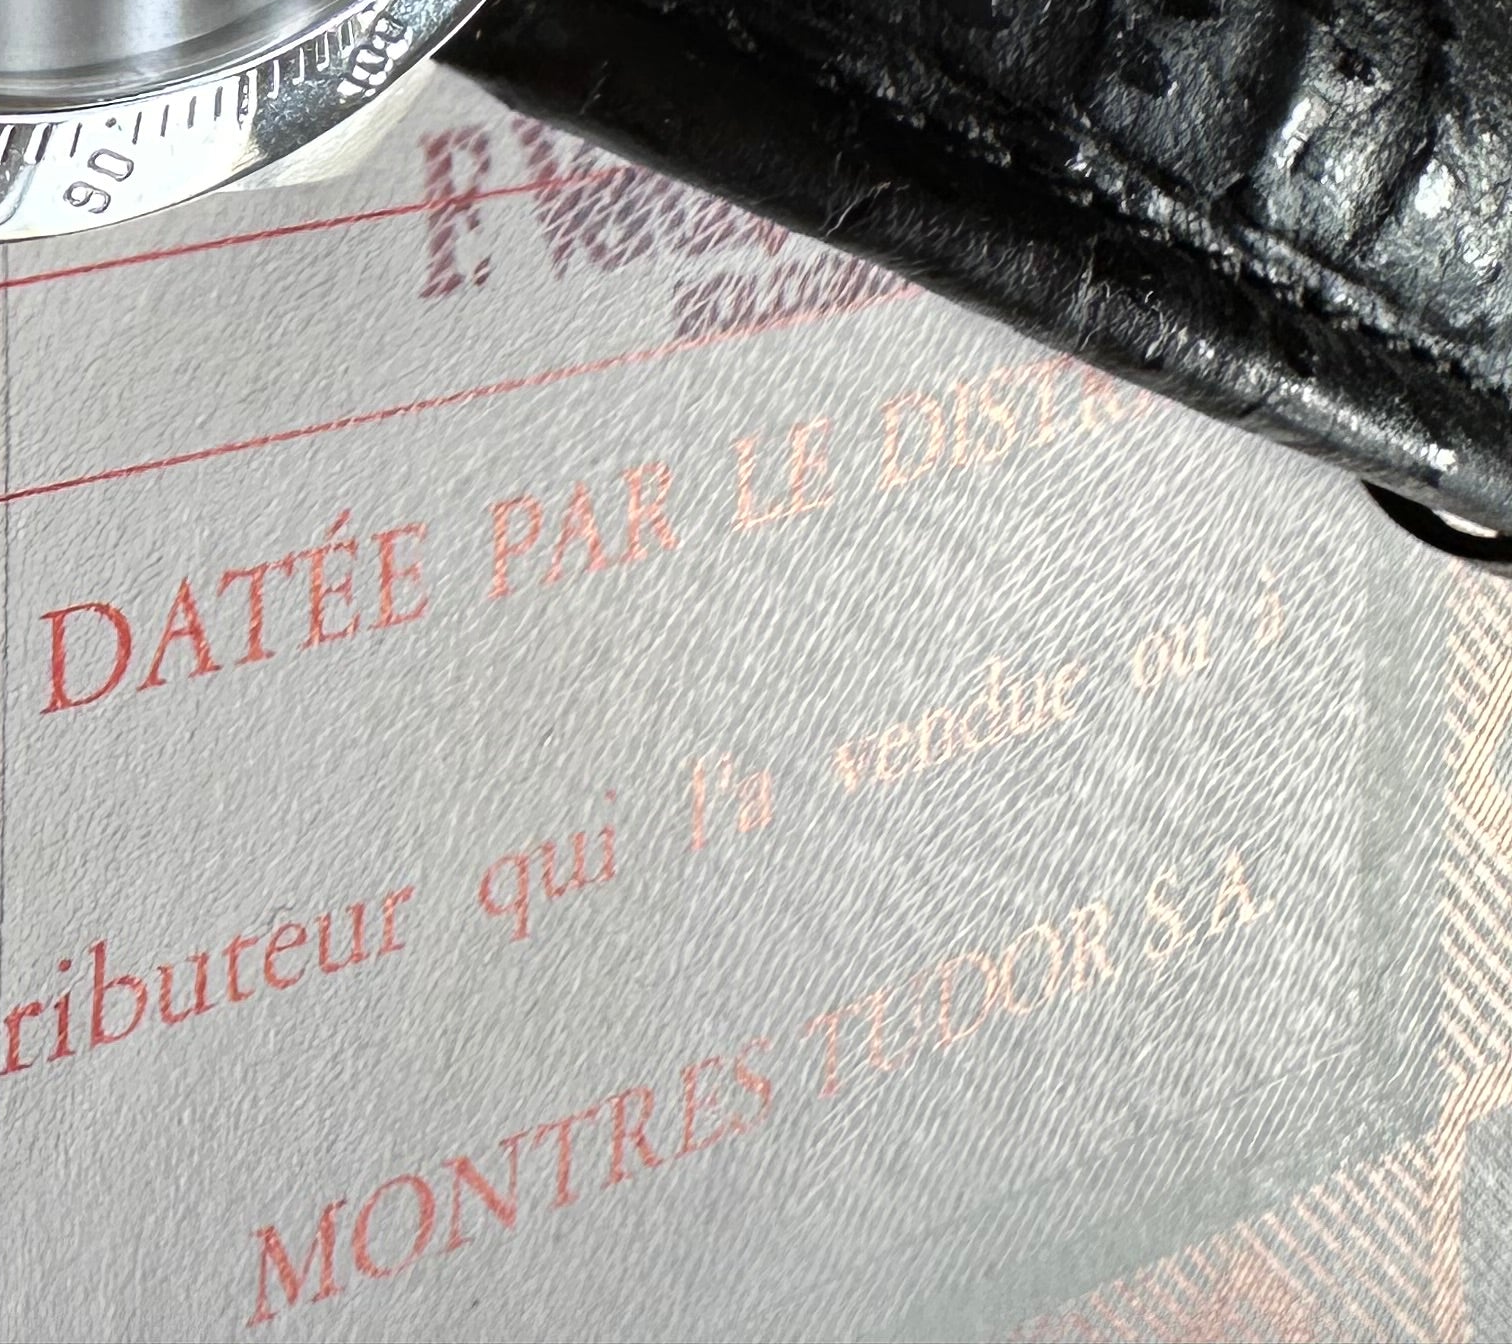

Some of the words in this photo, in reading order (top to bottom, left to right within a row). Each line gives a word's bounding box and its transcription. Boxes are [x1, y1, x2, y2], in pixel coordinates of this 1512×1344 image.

[64, 148, 134, 213] 90
[42, 509, 428, 714] DATÉE
[488, 459, 678, 599] PAR
[732, 418, 835, 531] LE
[479, 793, 621, 942] qui
[833, 653, 1088, 792] vendue
[1132, 613, 1211, 697] ou
[244, 1042, 774, 1327] MONTRES
[807, 900, 1117, 1099] TUDOR
